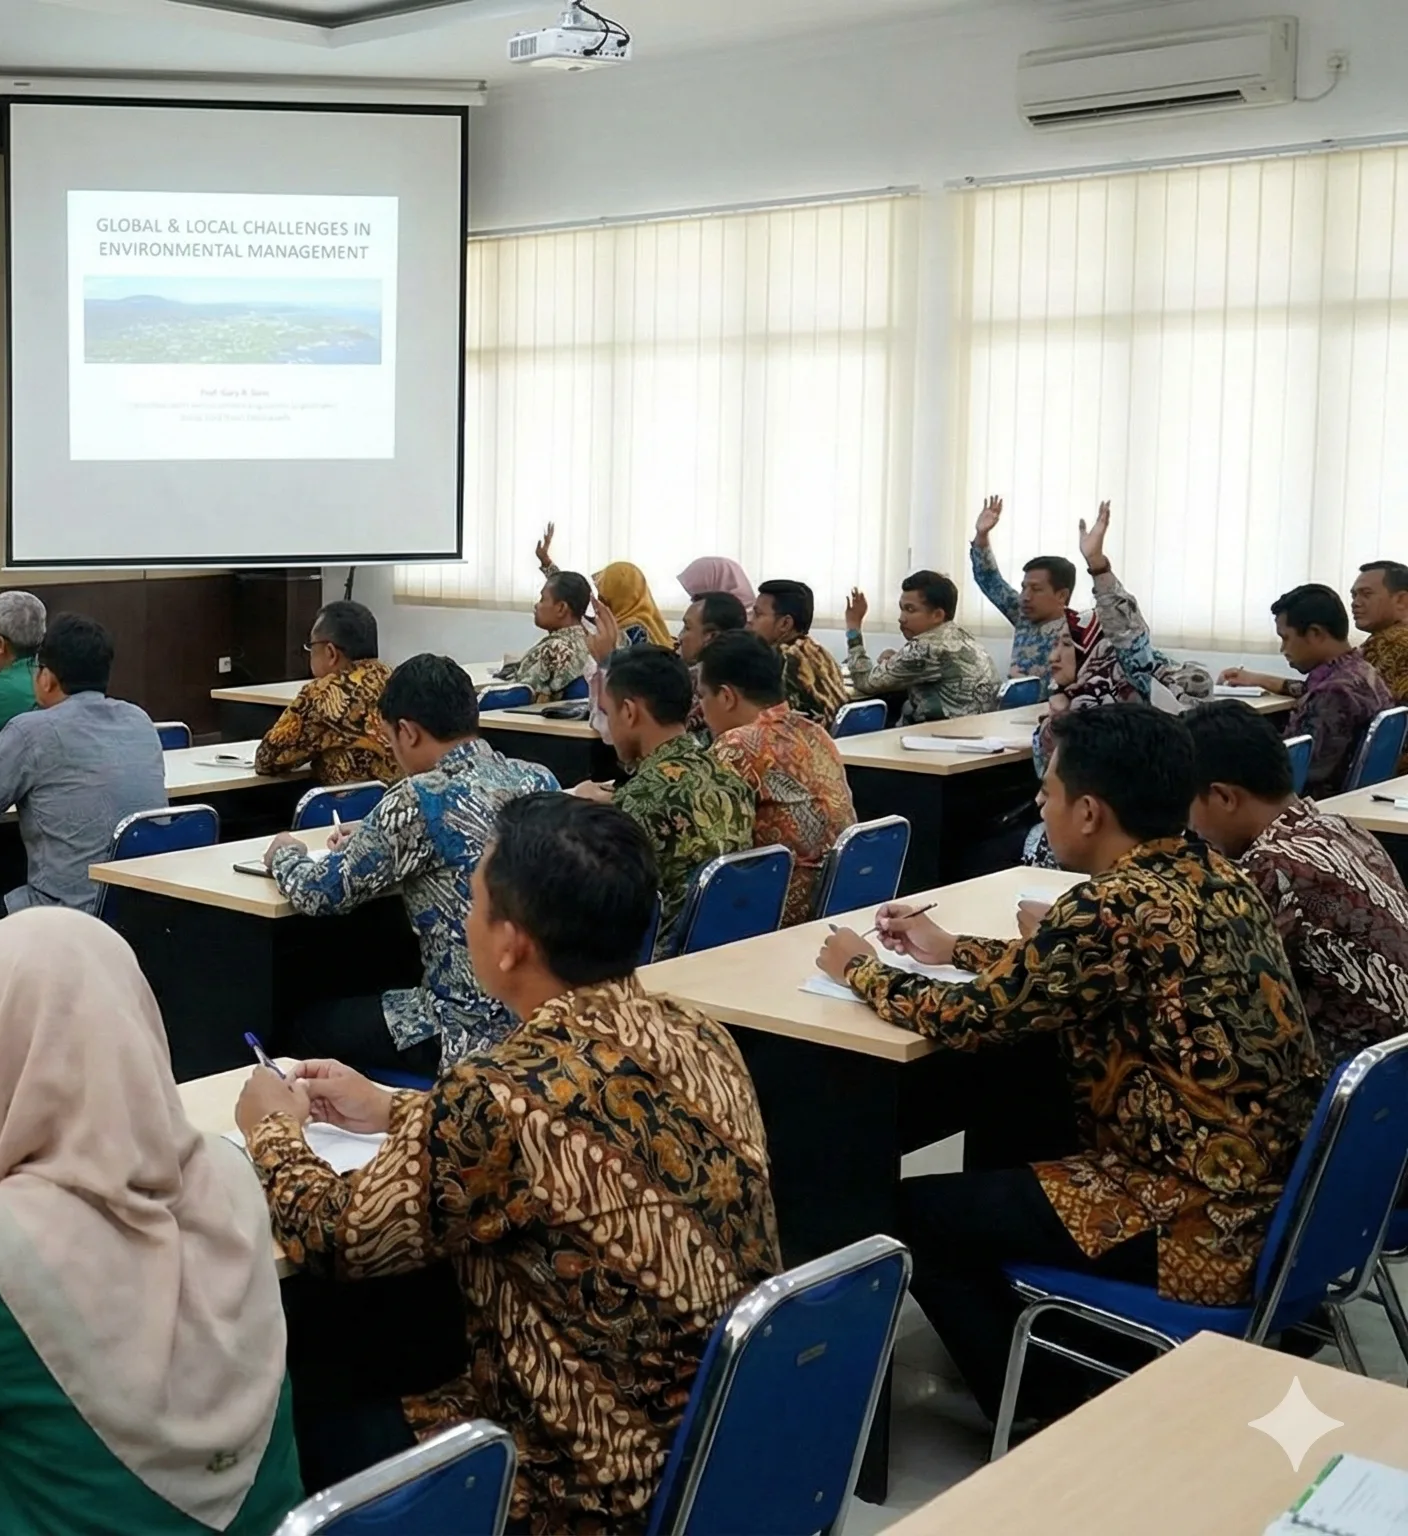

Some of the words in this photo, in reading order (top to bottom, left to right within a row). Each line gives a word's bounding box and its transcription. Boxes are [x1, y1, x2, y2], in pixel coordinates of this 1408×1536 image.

[96, 217, 163, 233] GLOBAL
[167, 218, 180, 233] &
[186, 219, 238, 234] LOCAL
[243, 220, 349, 236] CHALLENGES
[354, 222, 371, 236] IN
[99, 241, 243, 258] ENVIRONMENTAL
[247, 244, 370, 259] MANAGEMENT
